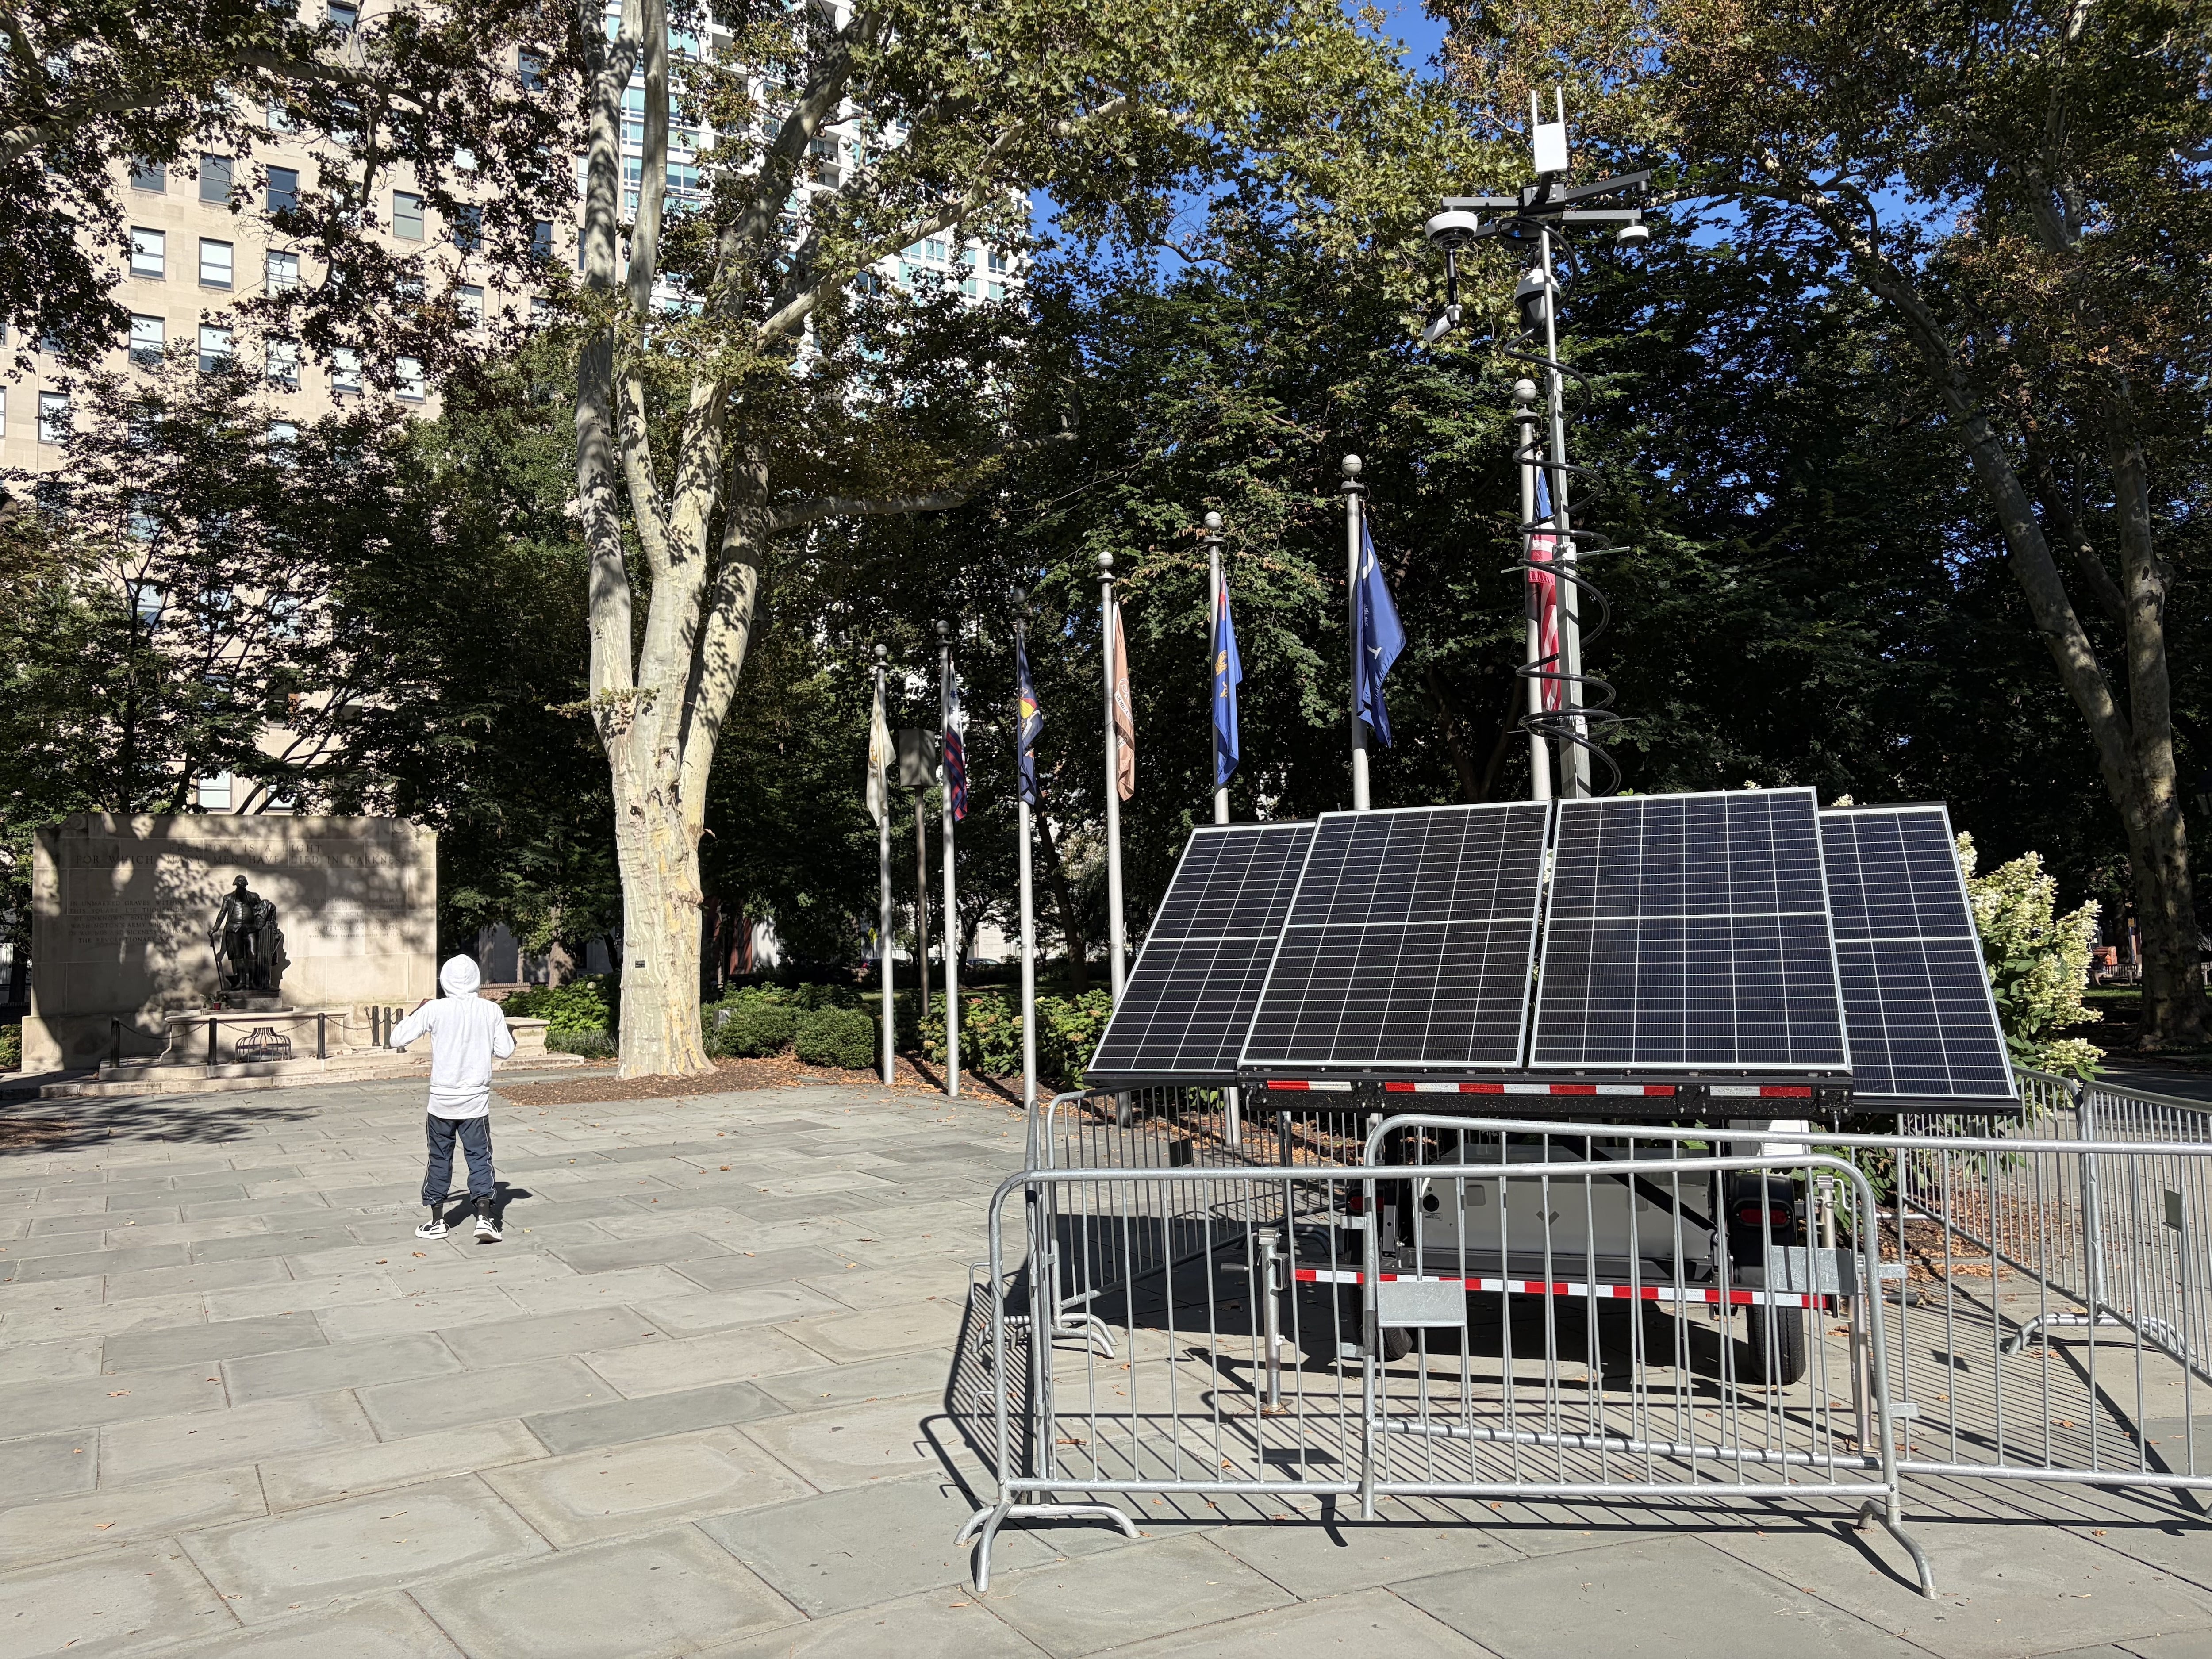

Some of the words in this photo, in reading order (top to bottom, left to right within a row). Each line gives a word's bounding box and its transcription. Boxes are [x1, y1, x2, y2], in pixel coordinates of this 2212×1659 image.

[169, 844, 232, 852] FREEDOM
[244, 844, 255, 852] IS
[265, 844, 271, 852] A
[283, 844, 322, 853] LIGHT
[76, 855, 99, 864] FOR
[109, 855, 153, 864] WHICH
[167, 856, 204, 864] MANY
[291, 856, 319, 864] DIED
[327, 856, 338, 864] IN
[349, 856, 407, 864] DARKNESS
